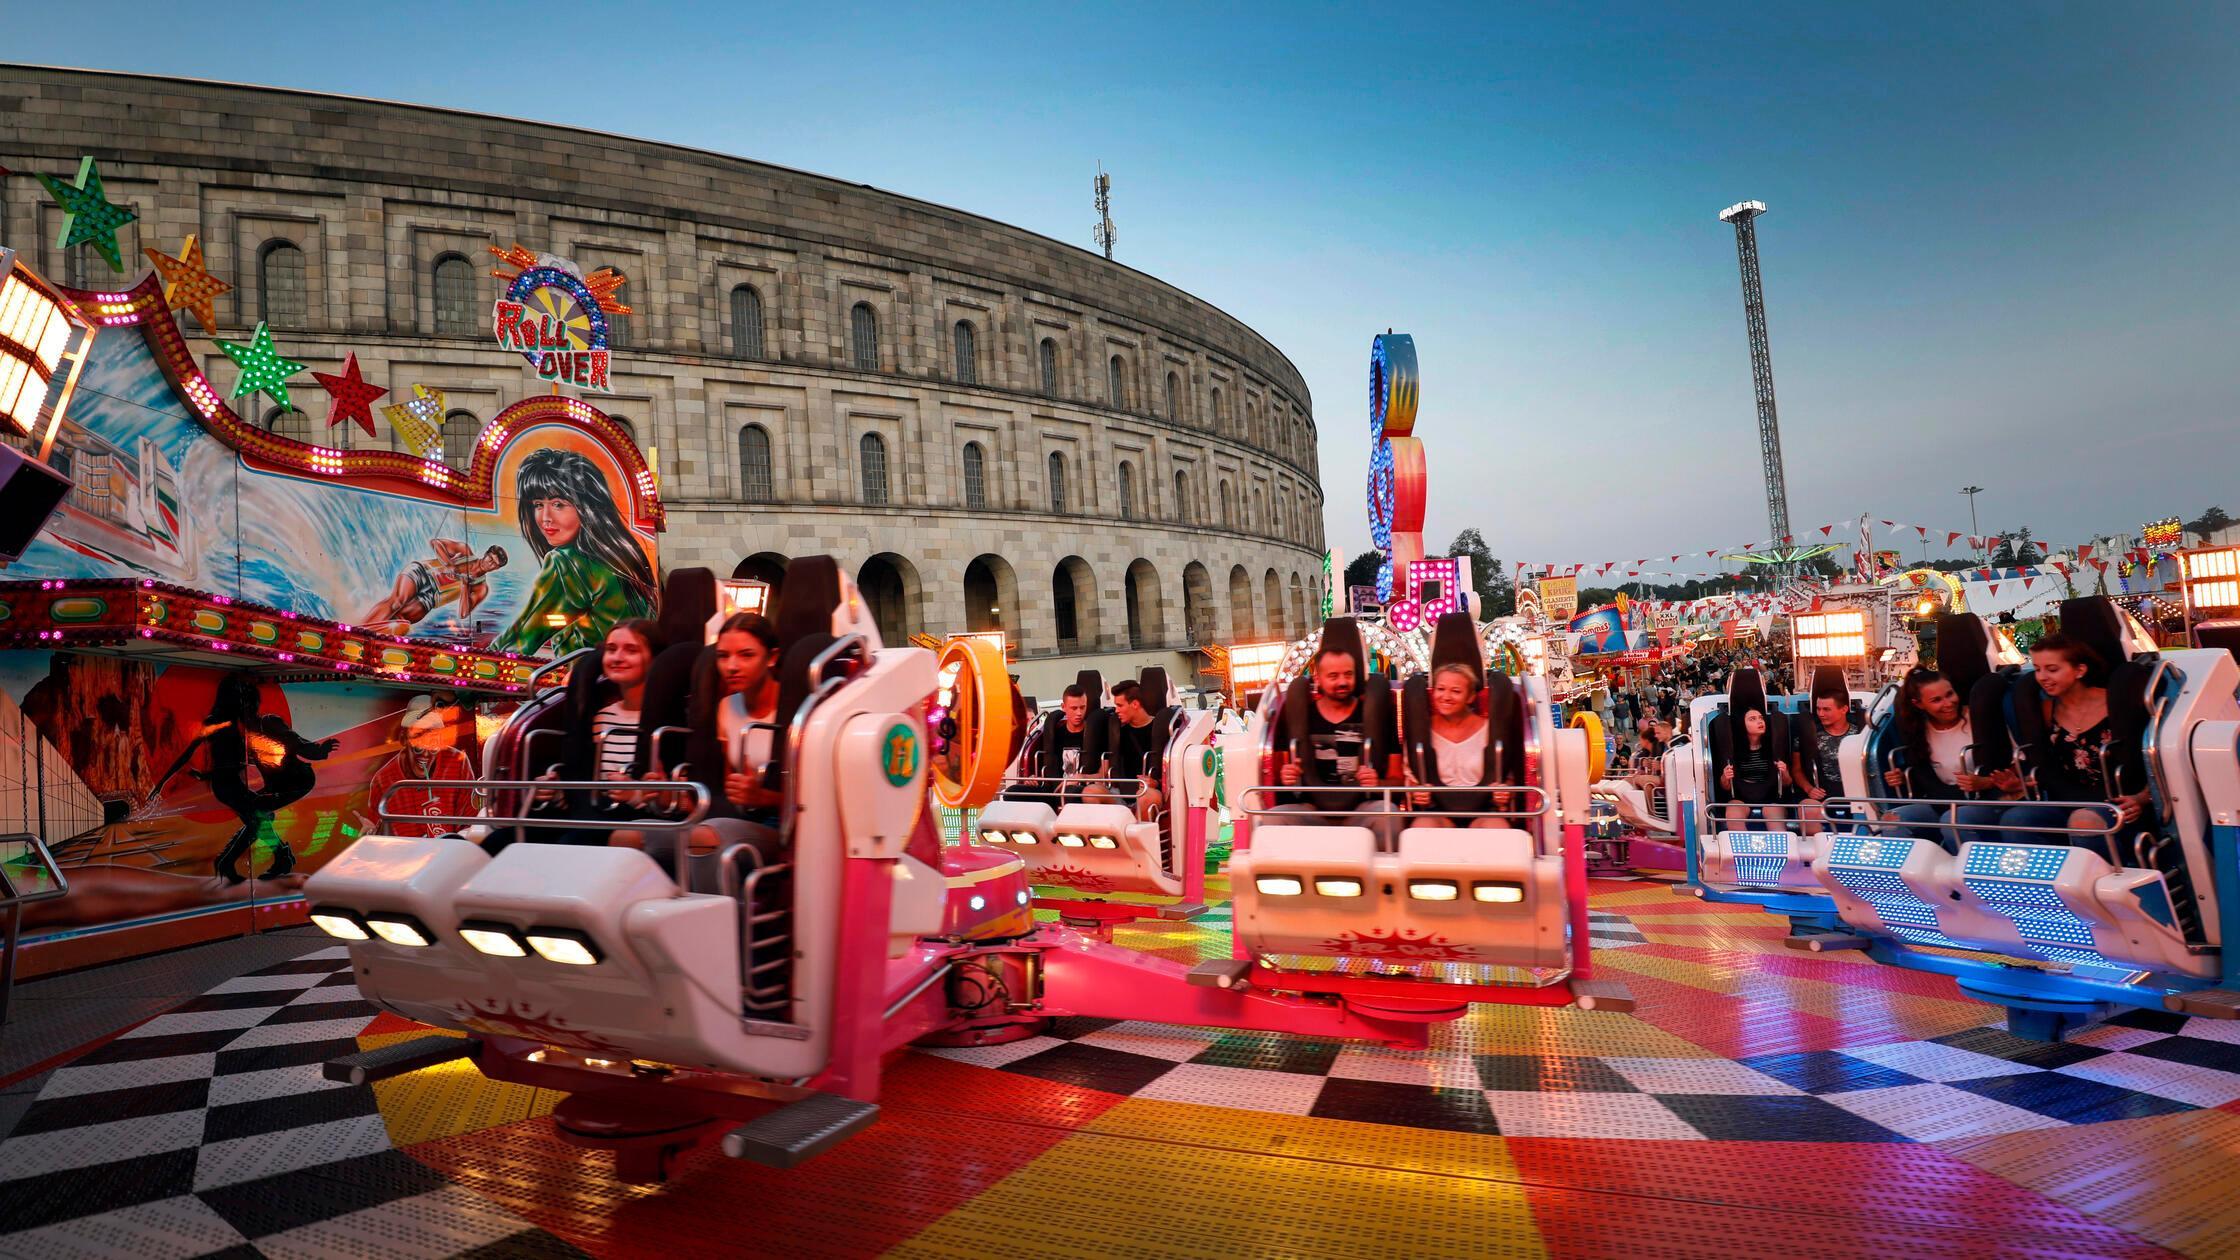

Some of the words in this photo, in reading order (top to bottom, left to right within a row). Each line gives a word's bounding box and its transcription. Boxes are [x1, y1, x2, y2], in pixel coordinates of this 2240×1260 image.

[496, 300, 572, 351] ROLL
[538, 350, 612, 393] OVER
[889, 735, 915, 777] 11
